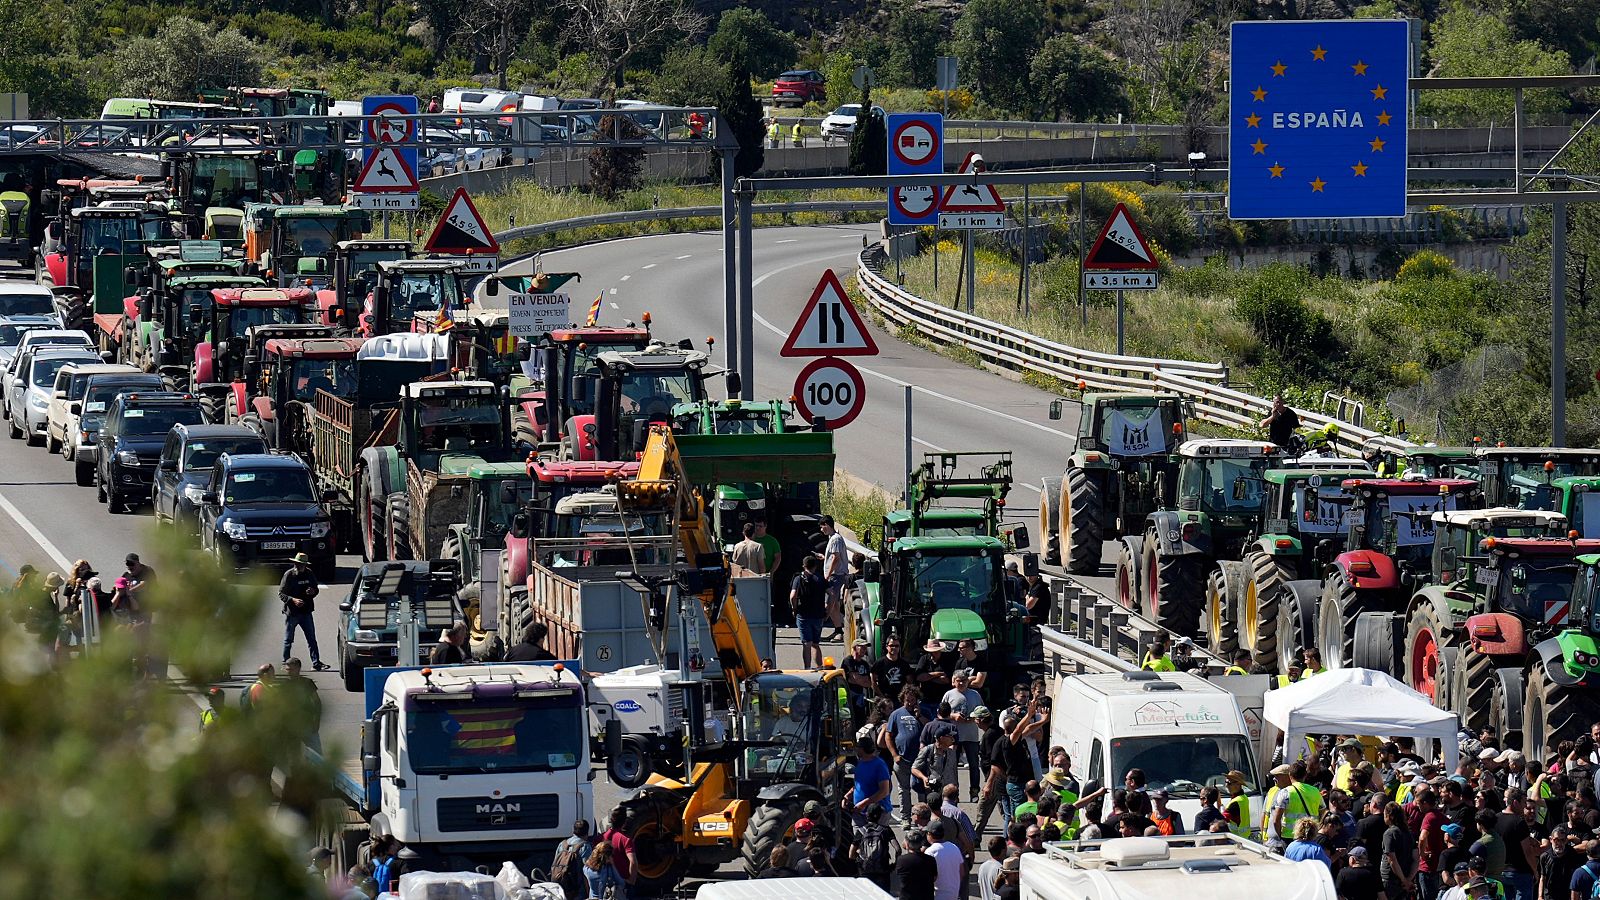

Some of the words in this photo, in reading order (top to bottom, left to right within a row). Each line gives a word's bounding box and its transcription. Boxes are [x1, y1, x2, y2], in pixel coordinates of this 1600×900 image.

[1272, 109, 1364, 129] ESPAÑA
[385, 199, 401, 207] km
[957, 217, 967, 225] 11
[970, 217, 986, 225] km
[1101, 276, 1118, 286] 3,5
[1123, 276, 1140, 285] km
[511, 296, 526, 306] EN
[529, 295, 565, 305] VENDA
[511, 310, 531, 318] GOVERN
[533, 309, 566, 317] INCOMPETENT
[511, 324, 532, 333] PAGESOS
[807, 382, 852, 406] 100
[1132, 443, 1150, 452] SOM
[1411, 530, 1421, 538] HI
[600, 647, 609, 660] 25
[1142, 712, 1220, 723] Mercafusta
[475, 803, 521, 814] MAN
[693, 822, 730, 831] JCB
